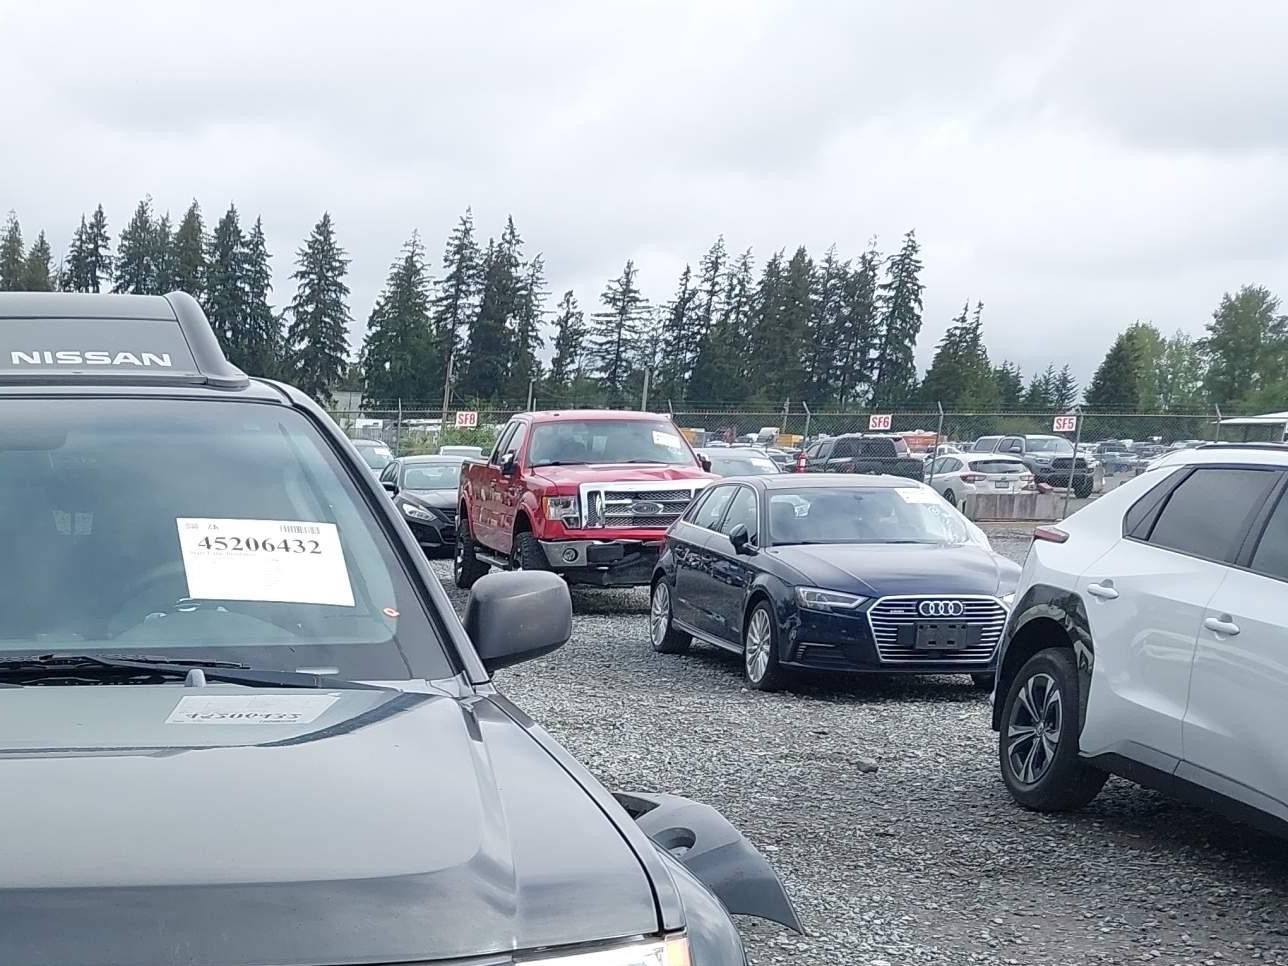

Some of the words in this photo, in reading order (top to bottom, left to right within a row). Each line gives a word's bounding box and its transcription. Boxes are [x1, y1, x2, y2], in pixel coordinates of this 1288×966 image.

[10, 351, 172, 367] NISSAN
[457, 413, 476, 425] SF8
[871, 416, 890, 428] SF6
[1055, 417, 1075, 430] SF5
[197, 536, 323, 555] 45206432
